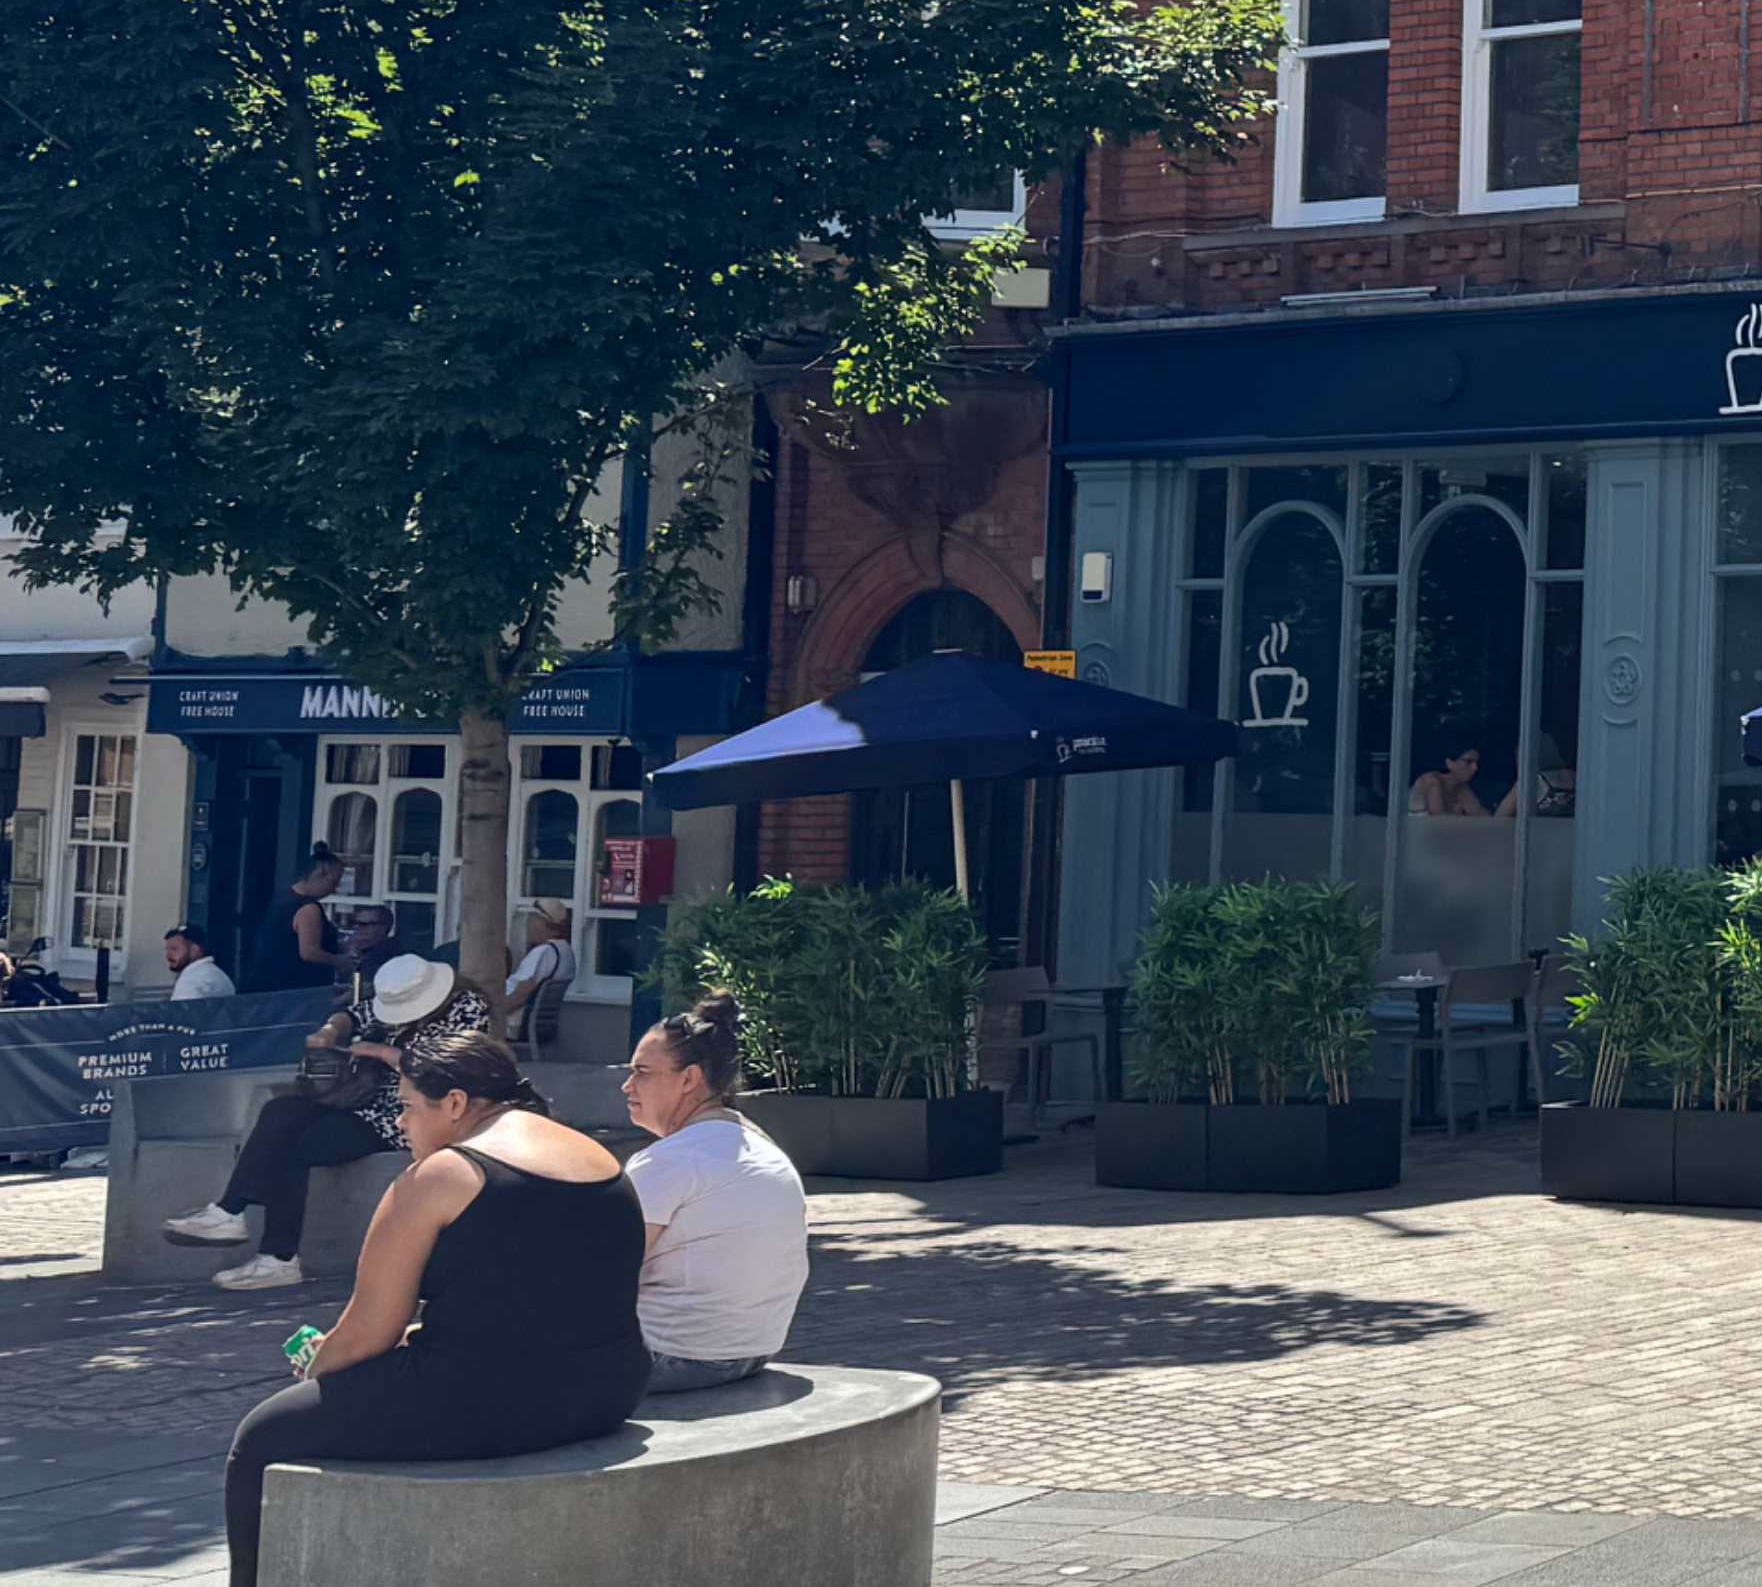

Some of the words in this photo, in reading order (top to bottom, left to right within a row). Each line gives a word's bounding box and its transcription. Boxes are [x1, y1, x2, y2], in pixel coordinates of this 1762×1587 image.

[179, 690, 207, 702] CRAFT
[208, 690, 240, 702] UNION
[555, 688, 590, 701] UNION
[180, 705, 202, 717] FREE
[204, 705, 236, 717] HOUSE
[523, 705, 548, 717] FREE
[550, 705, 584, 717] HOUSE
[108, 1026, 137, 1042] MORE
[139, 1023, 166, 1031] THAN
[176, 1025, 197, 1037] PUB
[180, 1043, 229, 1059] GREAT
[77, 1051, 153, 1068] PREMIUM
[180, 1056, 229, 1071] VALUE
[82, 1064, 148, 1080] BRANDS
[95, 1089, 115, 1101] AL
[79, 1102, 112, 1115] SPO
